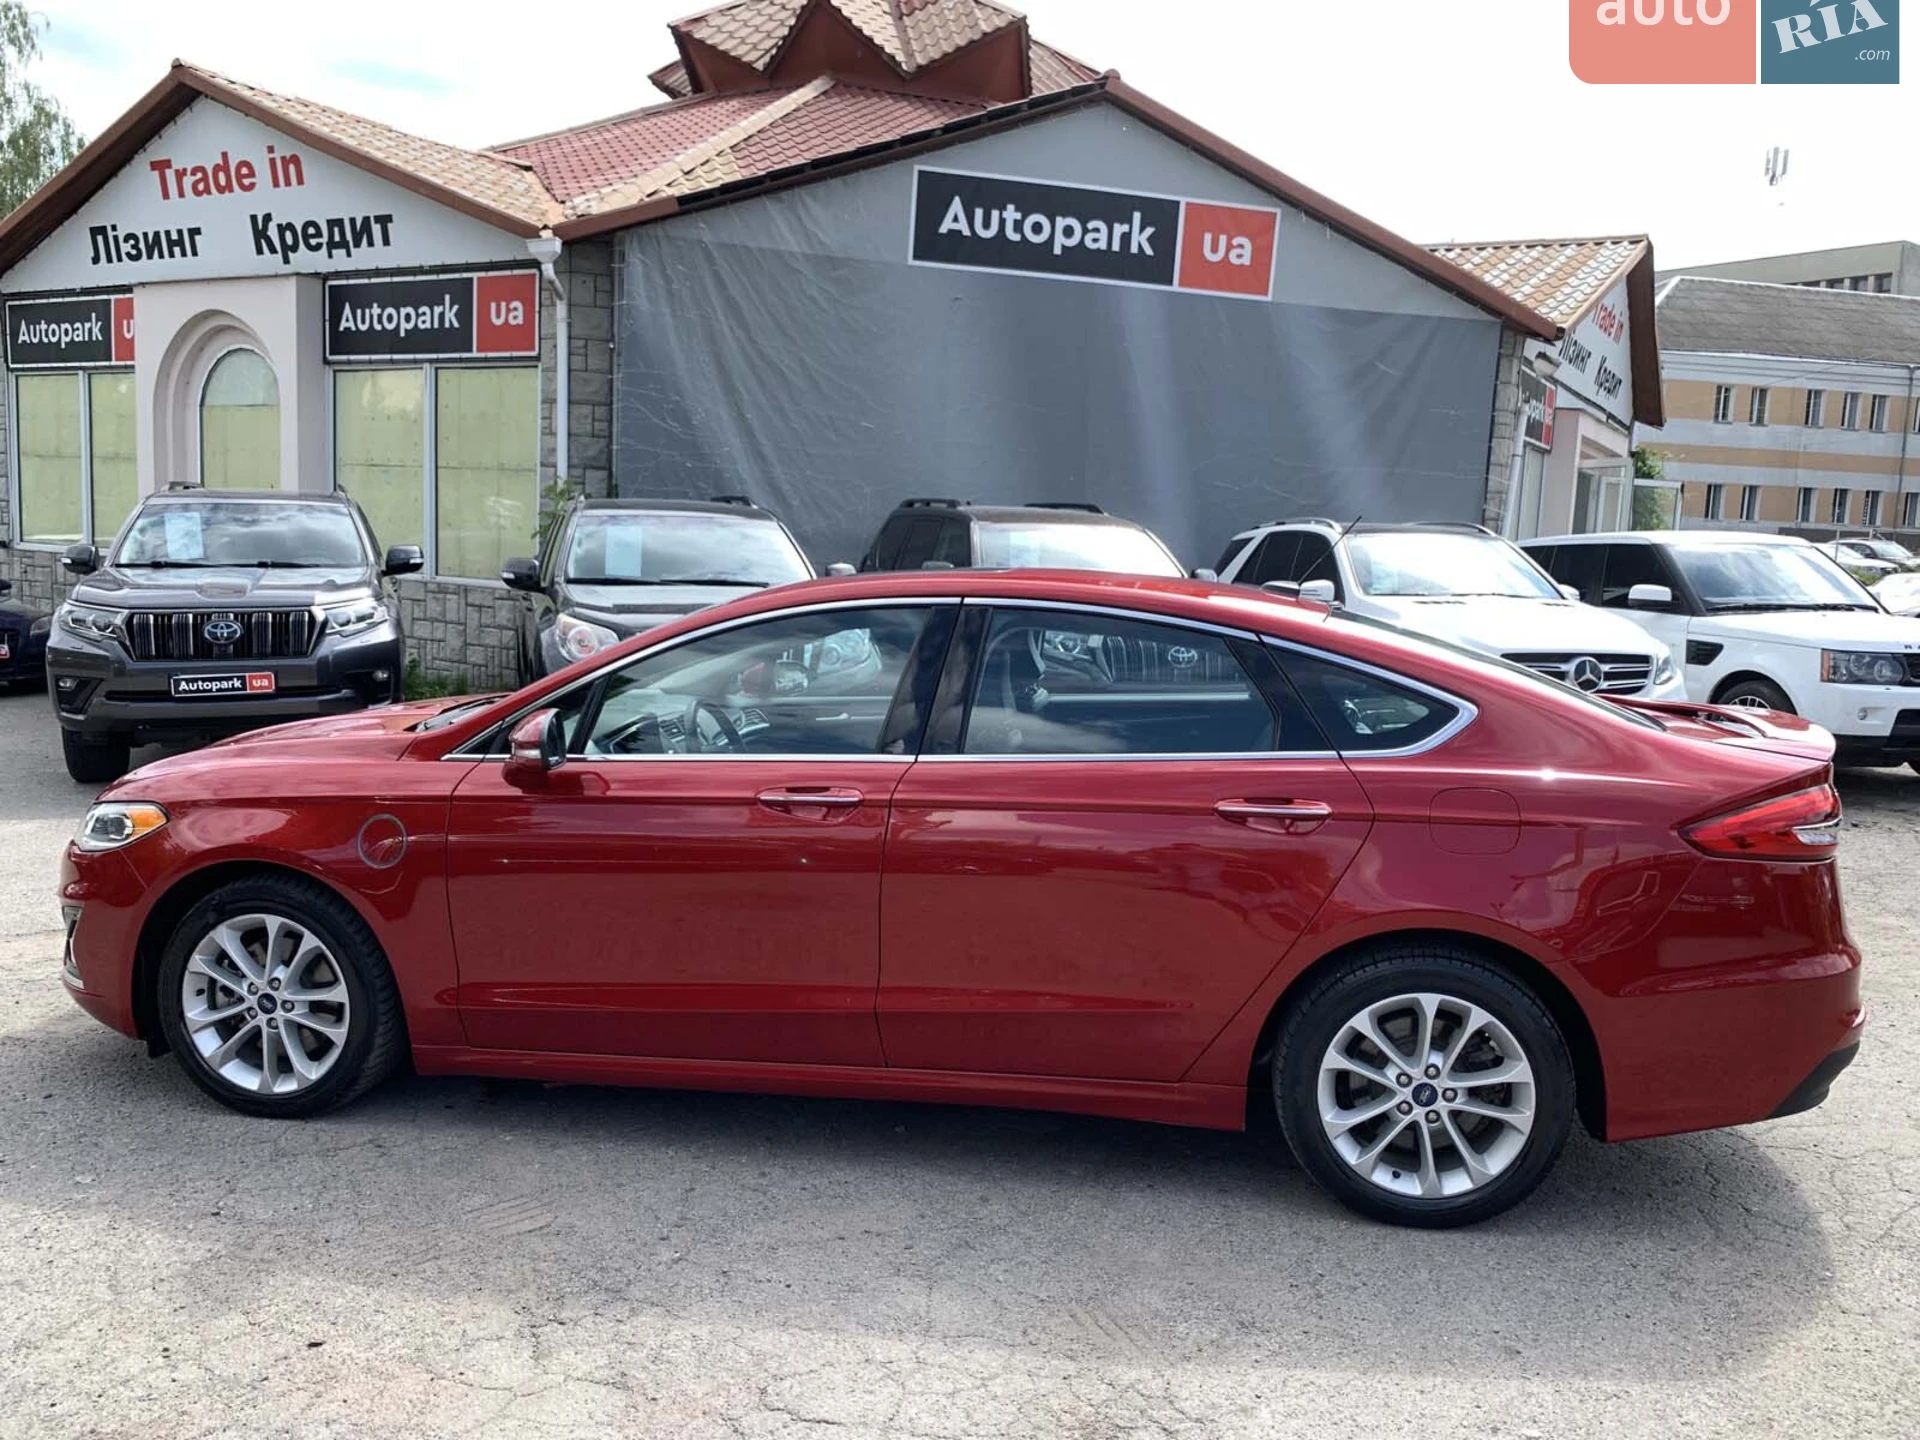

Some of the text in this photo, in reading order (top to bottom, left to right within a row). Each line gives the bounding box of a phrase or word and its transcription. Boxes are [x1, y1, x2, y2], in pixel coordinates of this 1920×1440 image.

[149, 145, 305, 200] Trade in
[89, 212, 394, 265] Лізинг Кредит
[938, 195, 1253, 266] Autopark ua
[18, 311, 135, 349] Autopark u
[339, 294, 524, 337] Autopark ua
[1594, 354, 1622, 400] Кредит
[179, 677, 269, 692] Autopark ua
